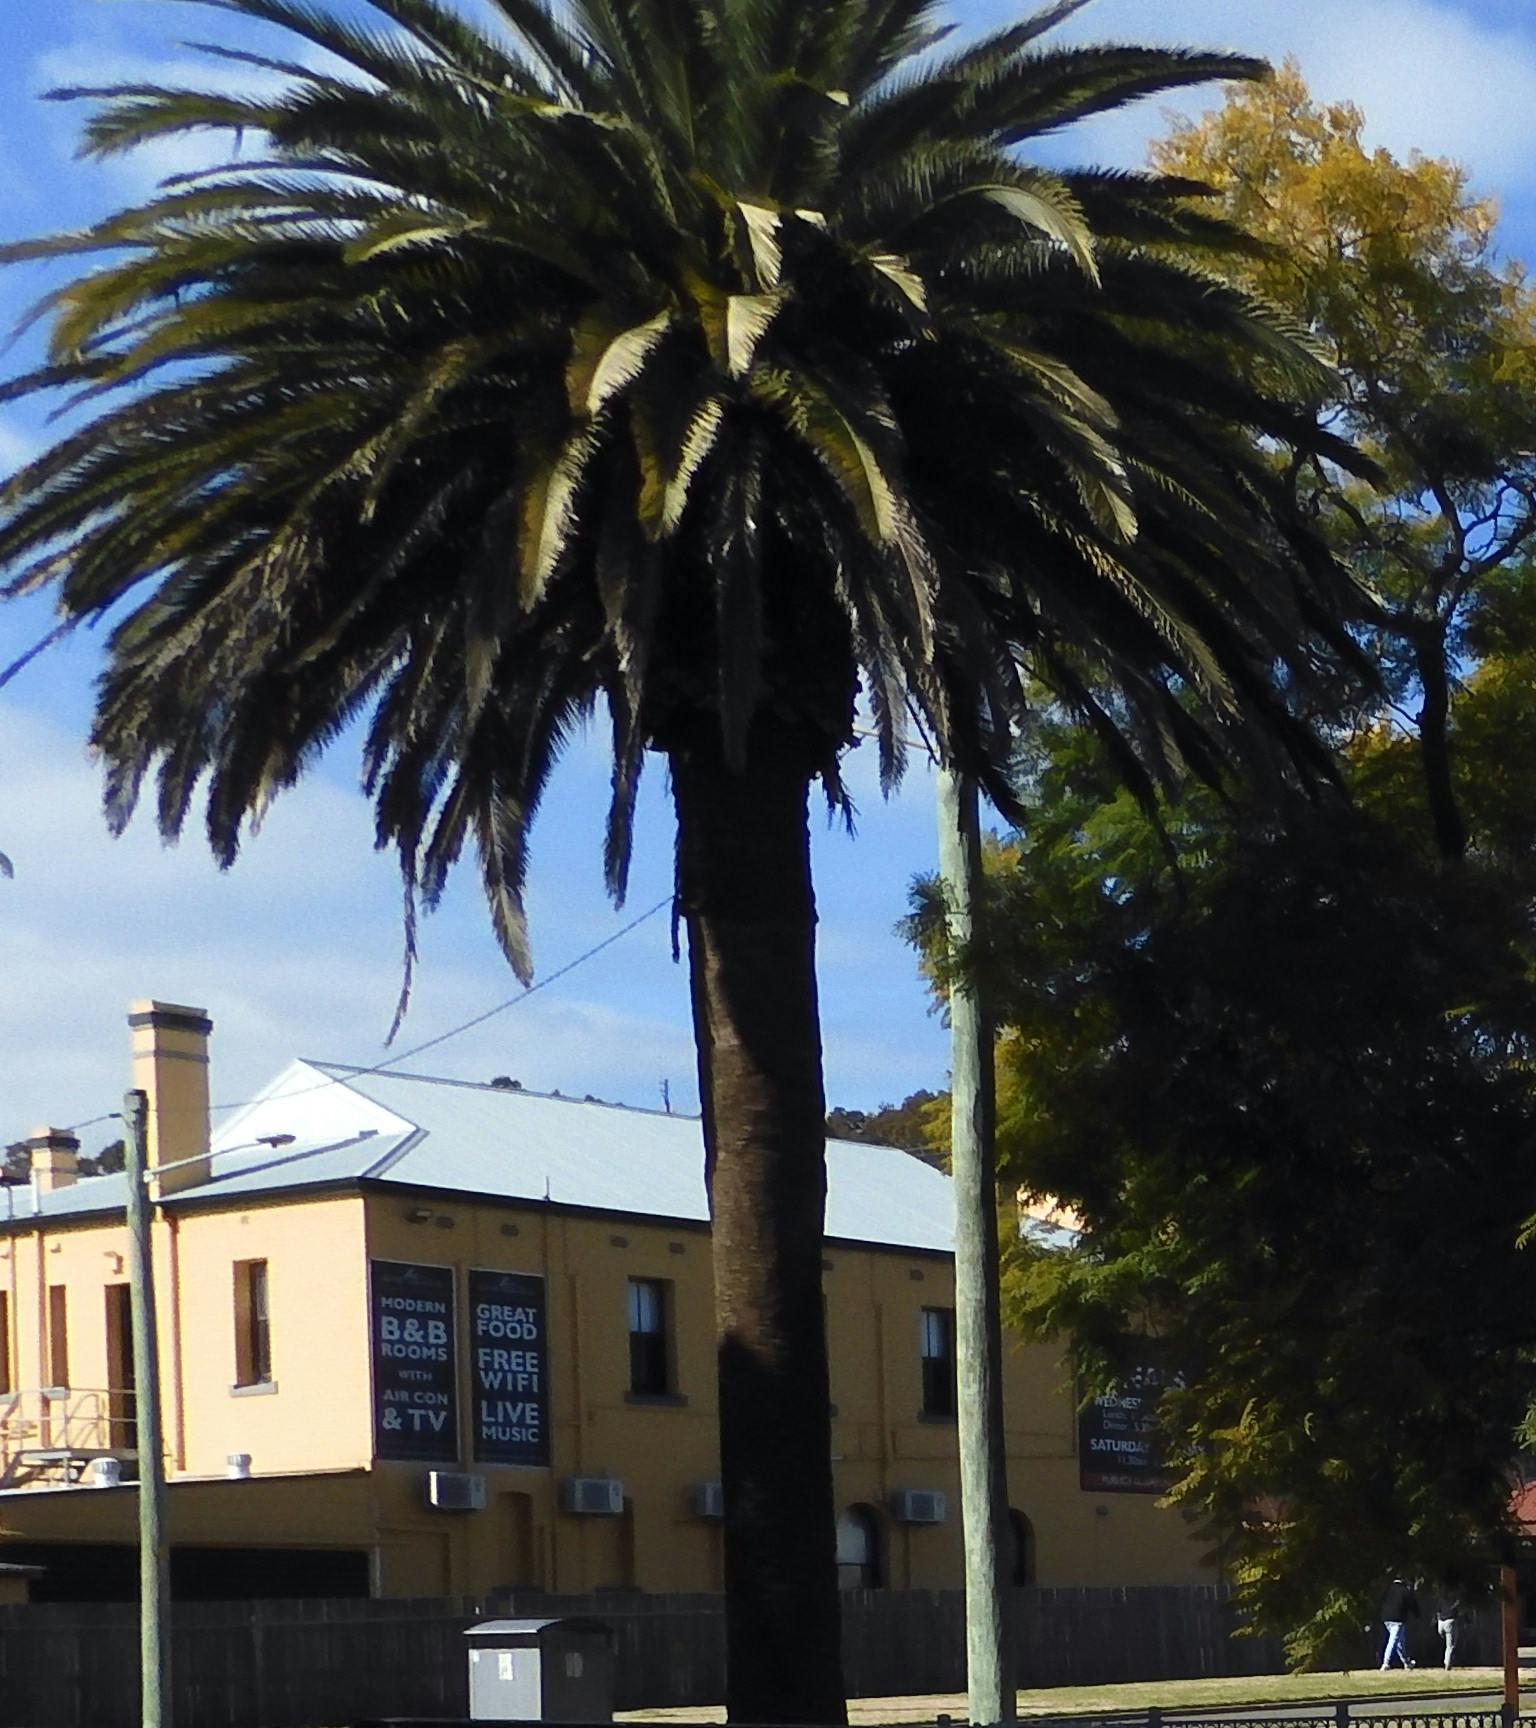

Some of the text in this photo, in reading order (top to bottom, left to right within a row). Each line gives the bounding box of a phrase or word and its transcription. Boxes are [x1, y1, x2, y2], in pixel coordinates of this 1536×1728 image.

[380, 1297, 447, 1314] MODERN
[476, 1303, 537, 1323] GREAT
[381, 1316, 448, 1345] B&B
[477, 1320, 538, 1341] FOOD
[381, 1343, 448, 1361] ROOMS
[478, 1349, 539, 1373] FREE
[399, 1370, 433, 1382] WITH
[479, 1370, 539, 1393] WIFI
[383, 1389, 448, 1406] AIR CON
[382, 1407, 448, 1432] & TV
[481, 1400, 540, 1425] LIVE
[482, 1426, 539, 1443] MUSIC
